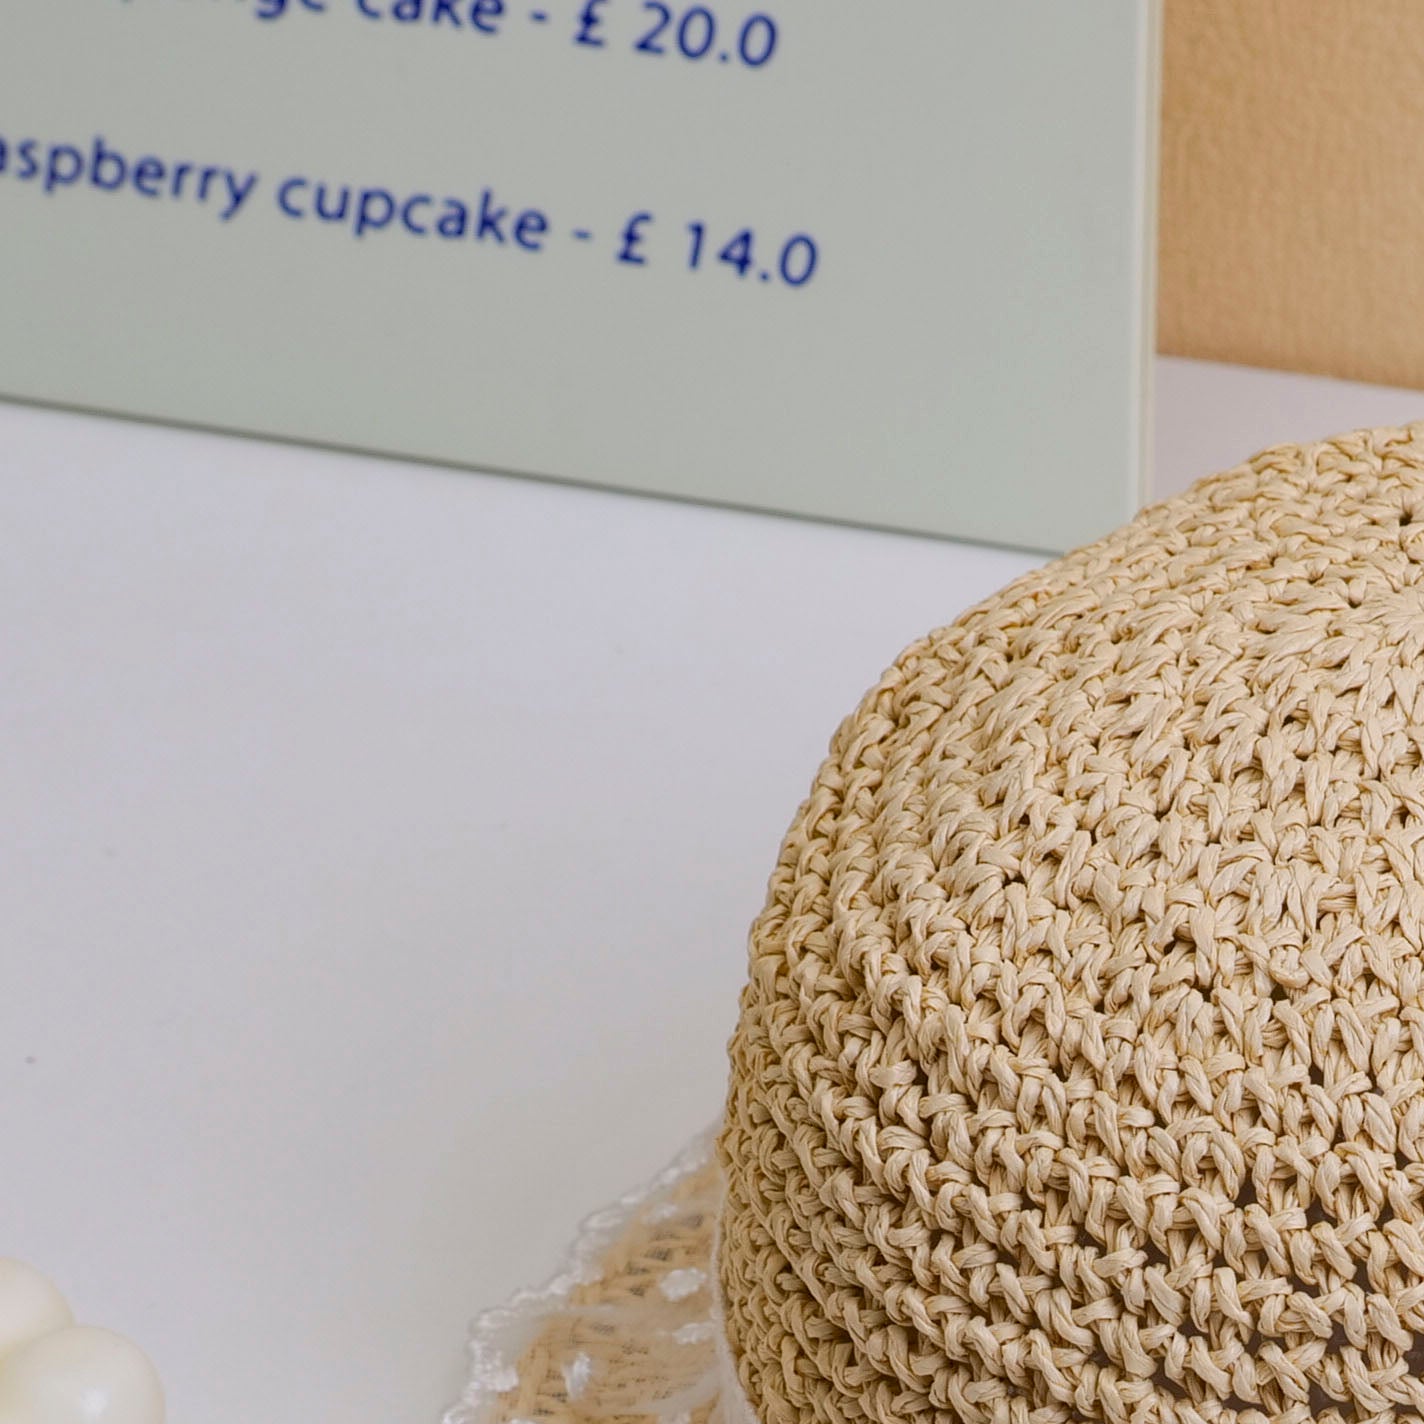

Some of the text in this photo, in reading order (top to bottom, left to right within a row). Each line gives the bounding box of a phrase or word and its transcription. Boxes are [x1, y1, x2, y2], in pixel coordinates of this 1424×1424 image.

[572, 0, 608, 49] £
[632, 0, 780, 70] 20.0
[275, 176, 551, 254] cupcake
[614, 211, 654, 268] £
[686, 221, 820, 289] 14.0
